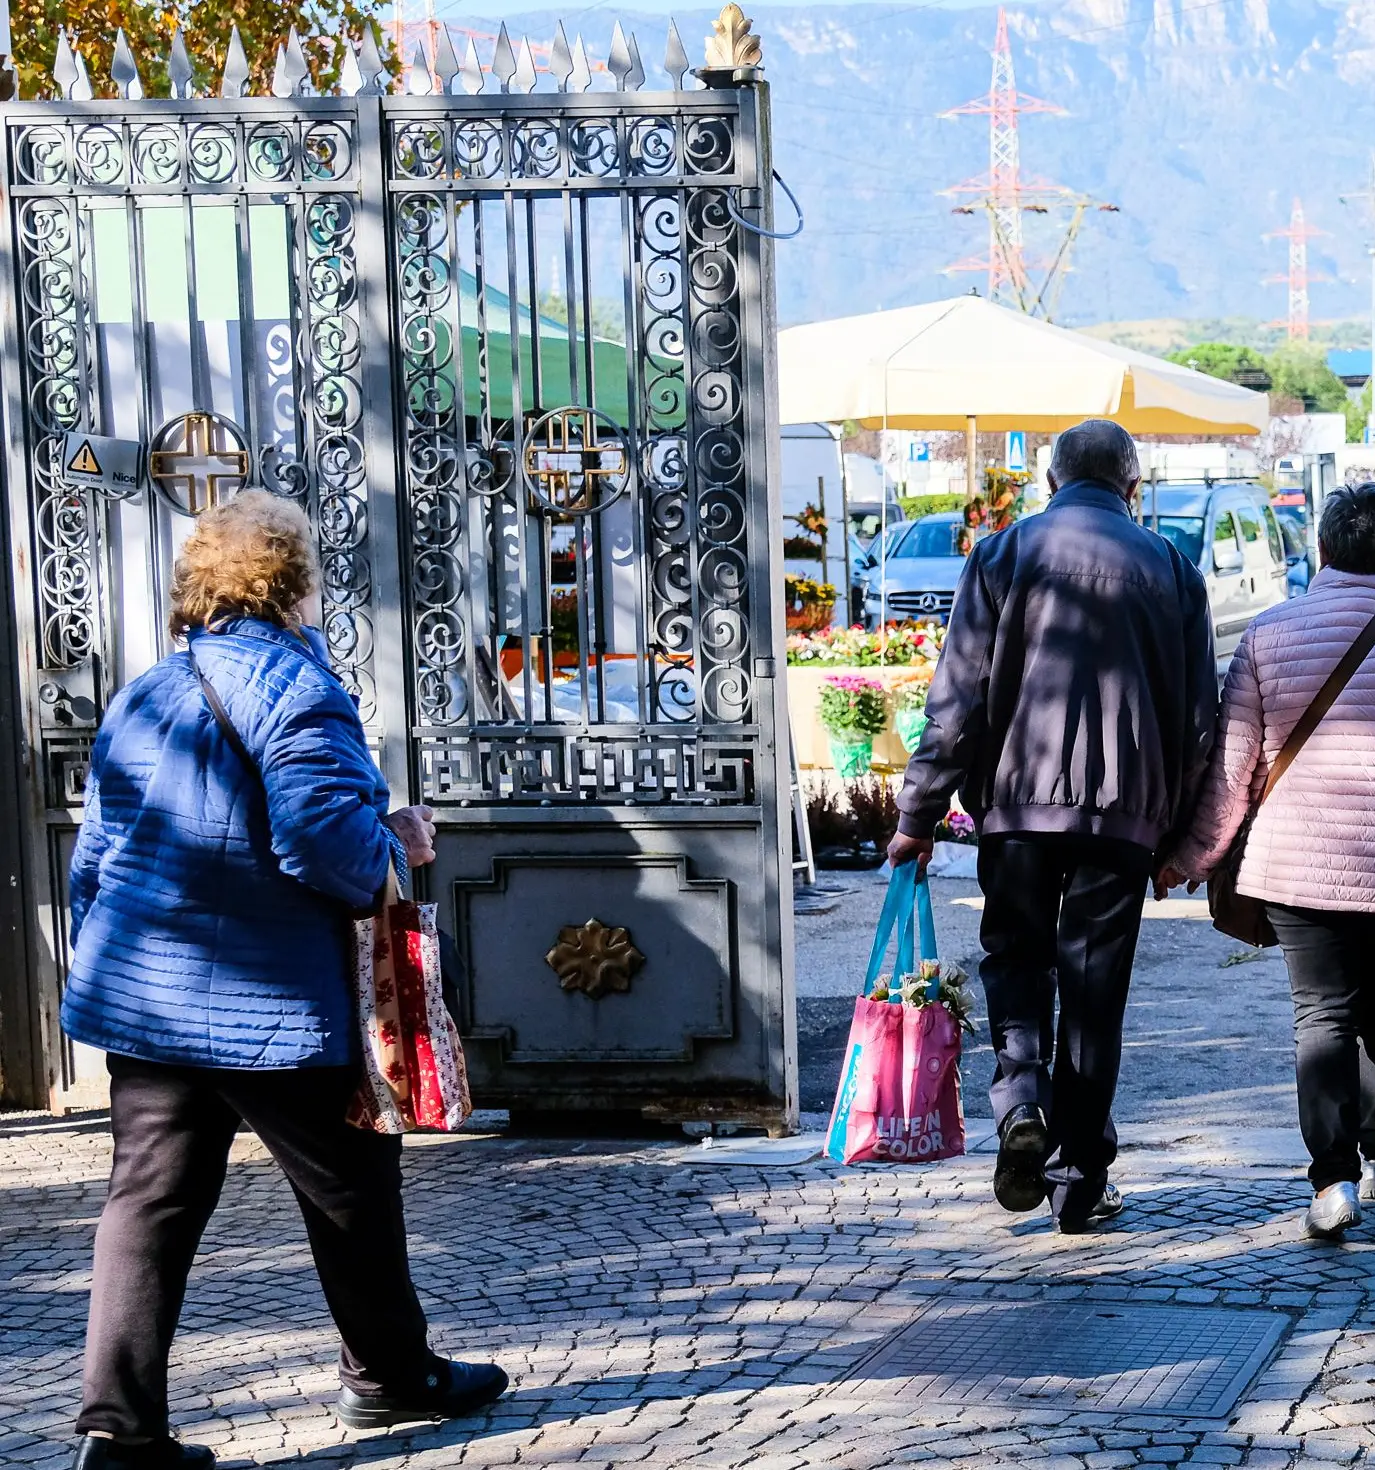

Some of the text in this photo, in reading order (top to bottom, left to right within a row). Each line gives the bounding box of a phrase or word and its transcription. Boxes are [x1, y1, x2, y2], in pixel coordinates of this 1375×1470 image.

[911, 442, 926, 461] P
[112, 471, 137, 484] Nice
[876, 1116, 922, 1138] LIFE
[872, 1131, 945, 1158] COLOR
